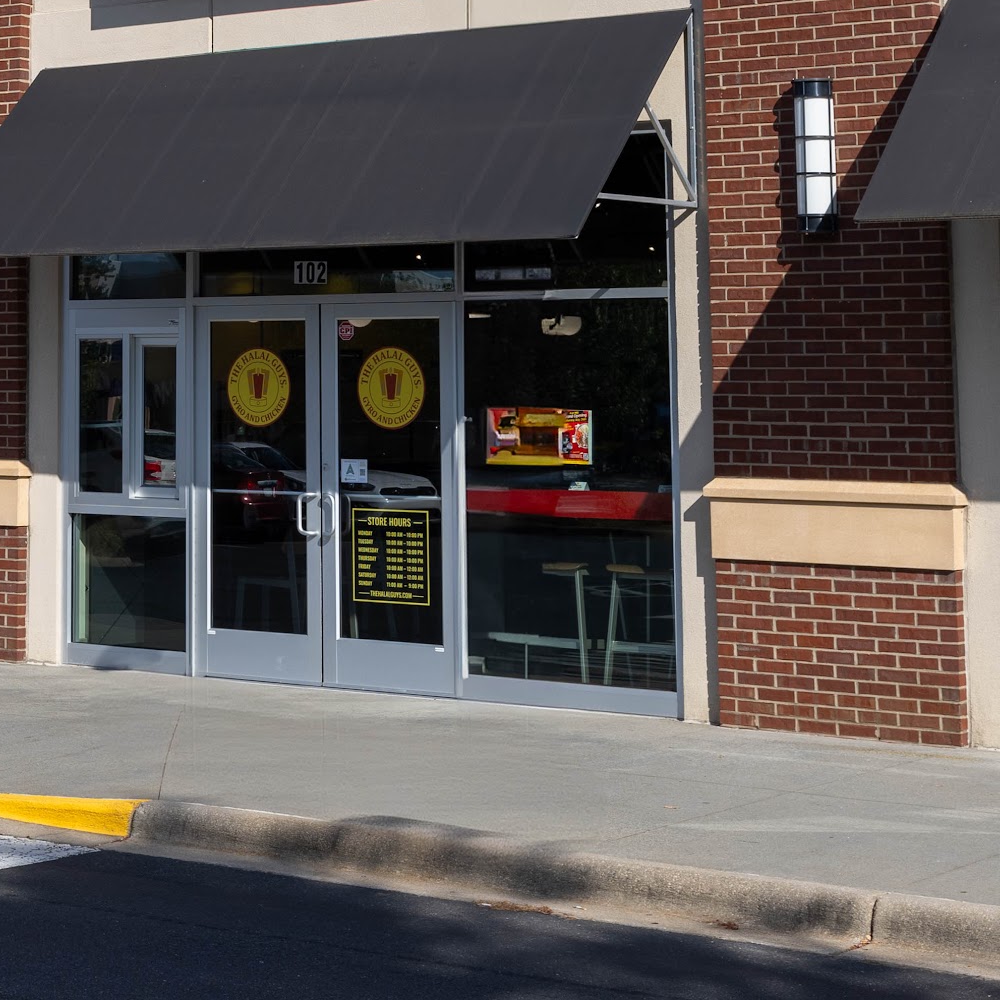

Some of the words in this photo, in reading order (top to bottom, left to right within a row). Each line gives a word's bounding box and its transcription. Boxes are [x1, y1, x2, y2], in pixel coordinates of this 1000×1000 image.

[296, 261, 326, 284] 102
[230, 362, 243, 384] THE
[242, 351, 271, 366] HALAL
[360, 362, 373, 385] THE
[372, 350, 403, 366] HALAL
[231, 395, 246, 417] GYRO
[245, 413, 260, 423] AND
[260, 396, 287, 423] CHICKEN
[362, 396, 378, 418] GYRO
[377, 414, 393, 425] AND
[393, 397, 421, 424] CHICKEN
[367, 516, 388, 526] STORE
[389, 517, 412, 527] HOURS
